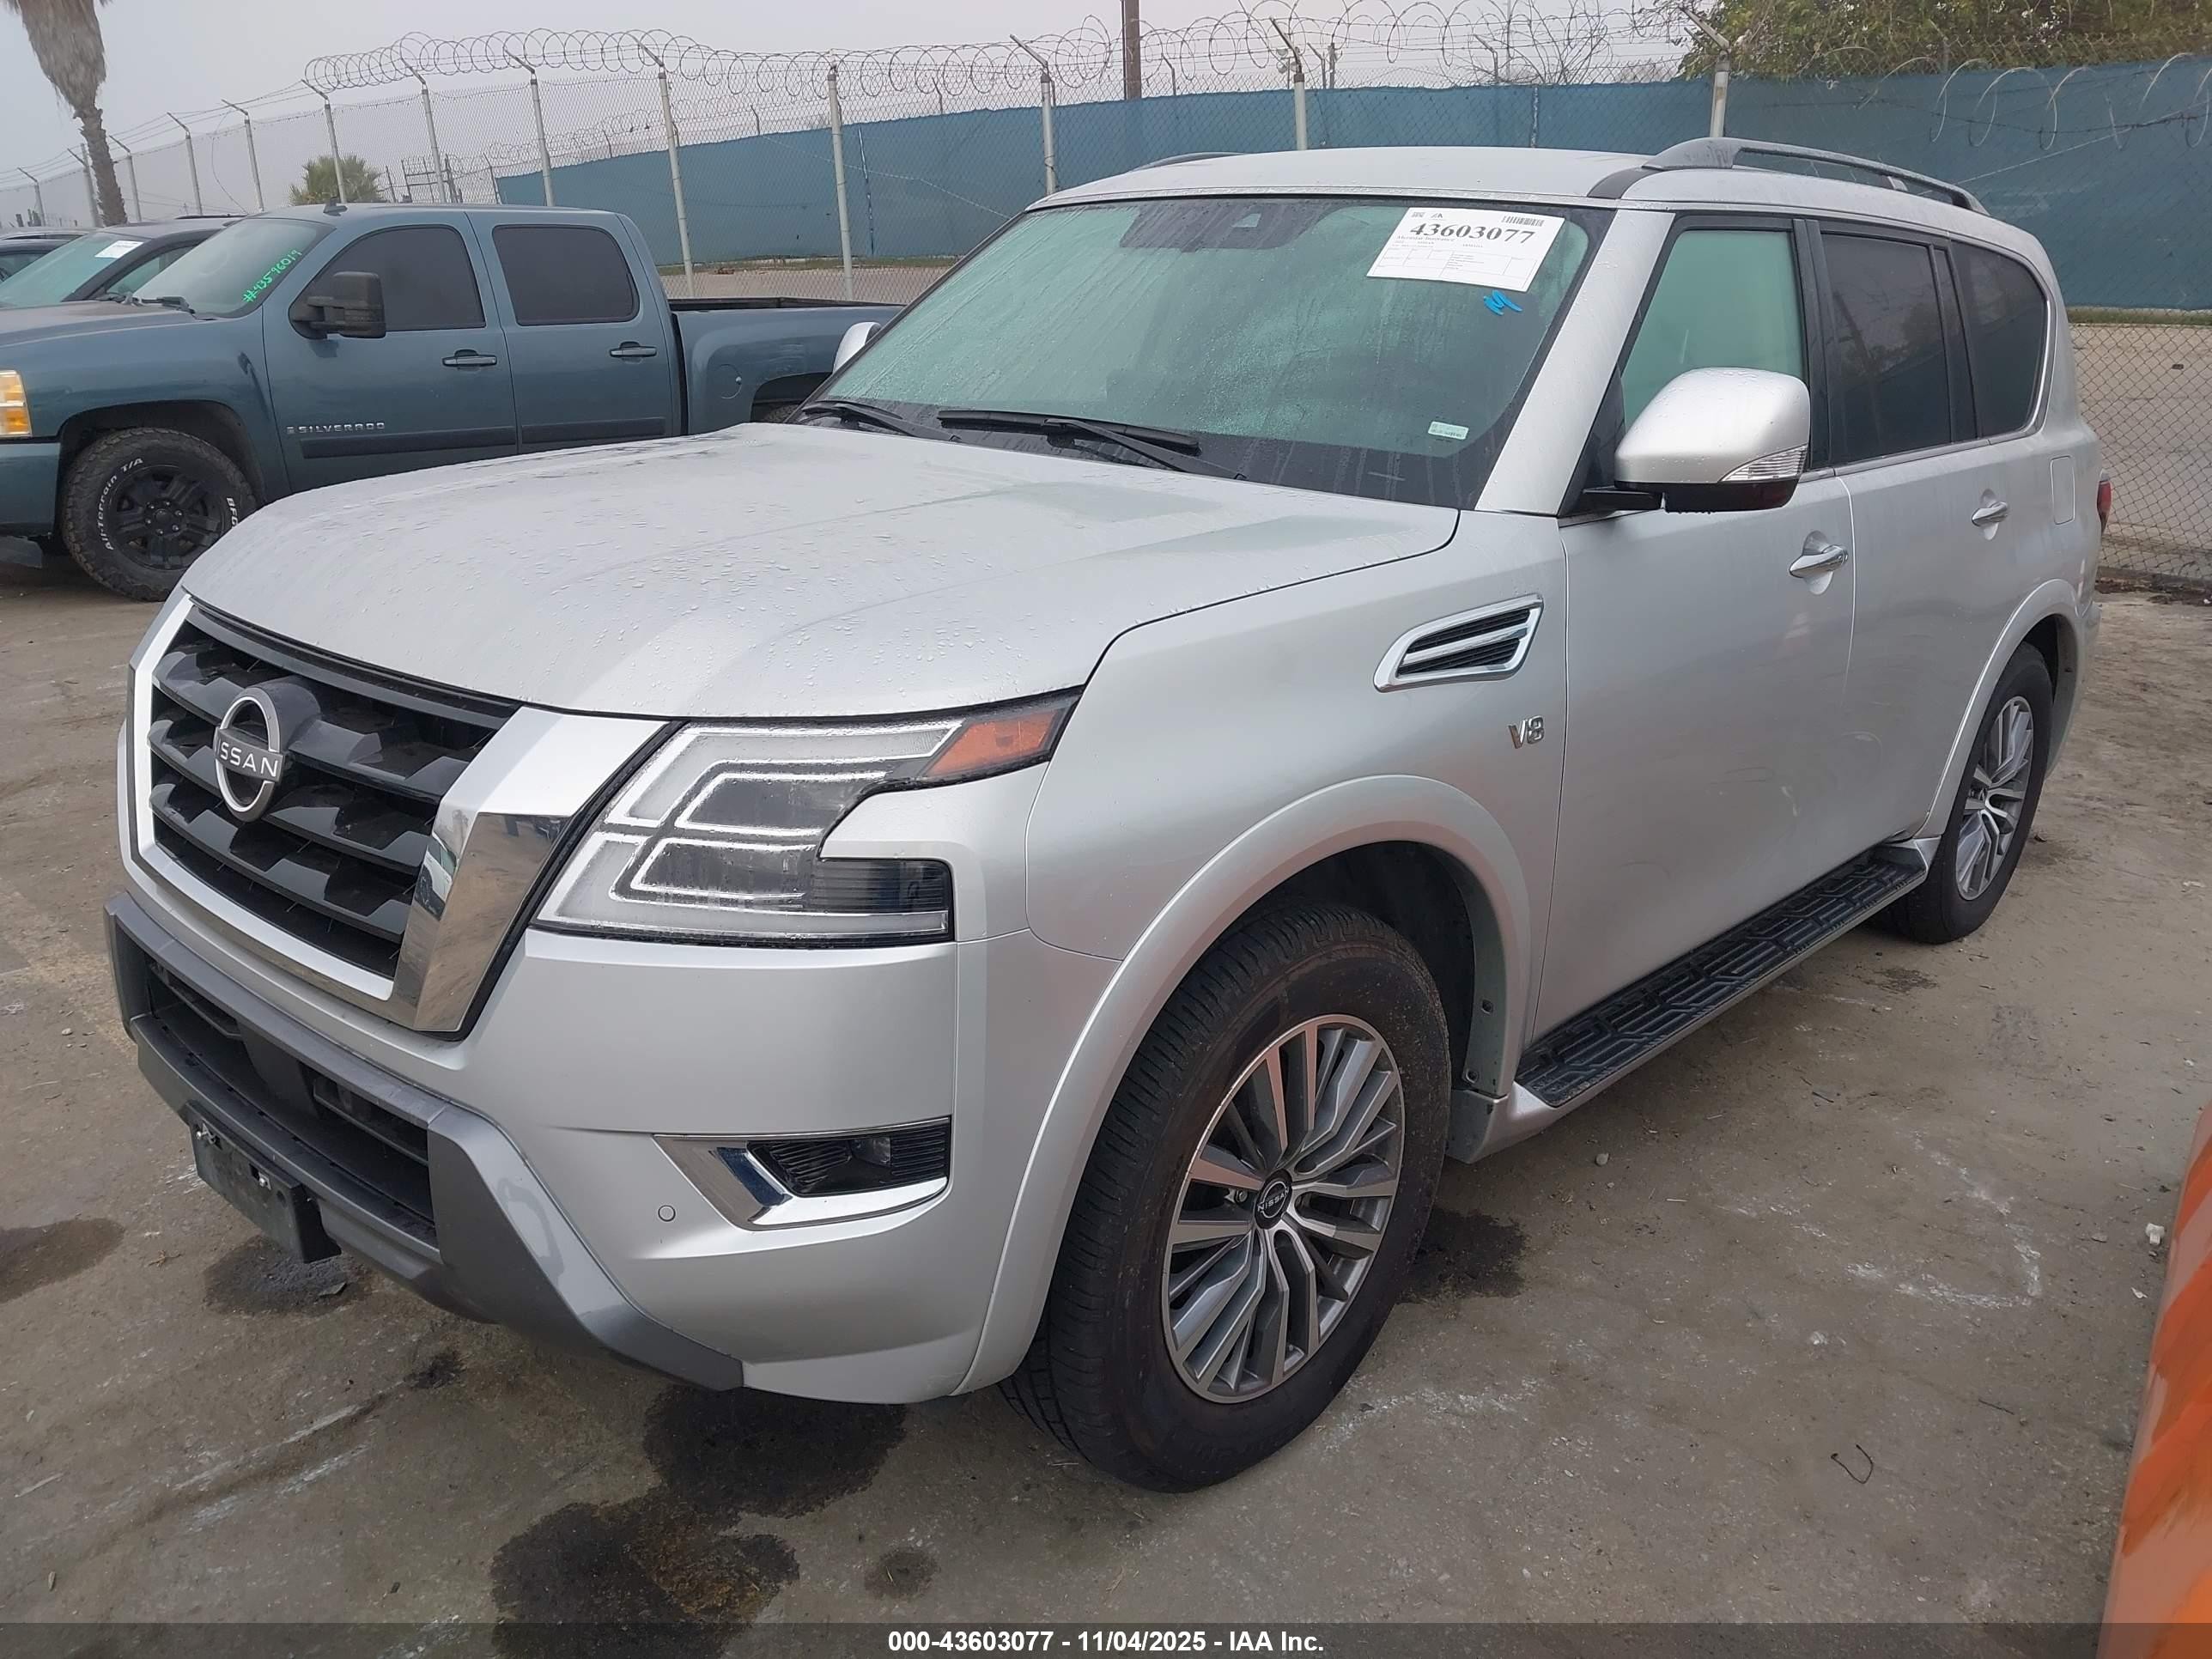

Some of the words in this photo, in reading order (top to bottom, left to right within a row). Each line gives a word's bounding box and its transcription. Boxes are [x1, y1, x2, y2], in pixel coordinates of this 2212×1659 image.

[1410, 222, 1536, 244] 43603077
[298, 422, 386, 434] SILVERADO
[96, 475, 118, 550] All-Terrain
[120, 458, 144, 473] T/A
[1508, 714, 1545, 750] V8
[217, 738, 279, 778] ISSAN
[1257, 1186, 1290, 1212] NISSAN
